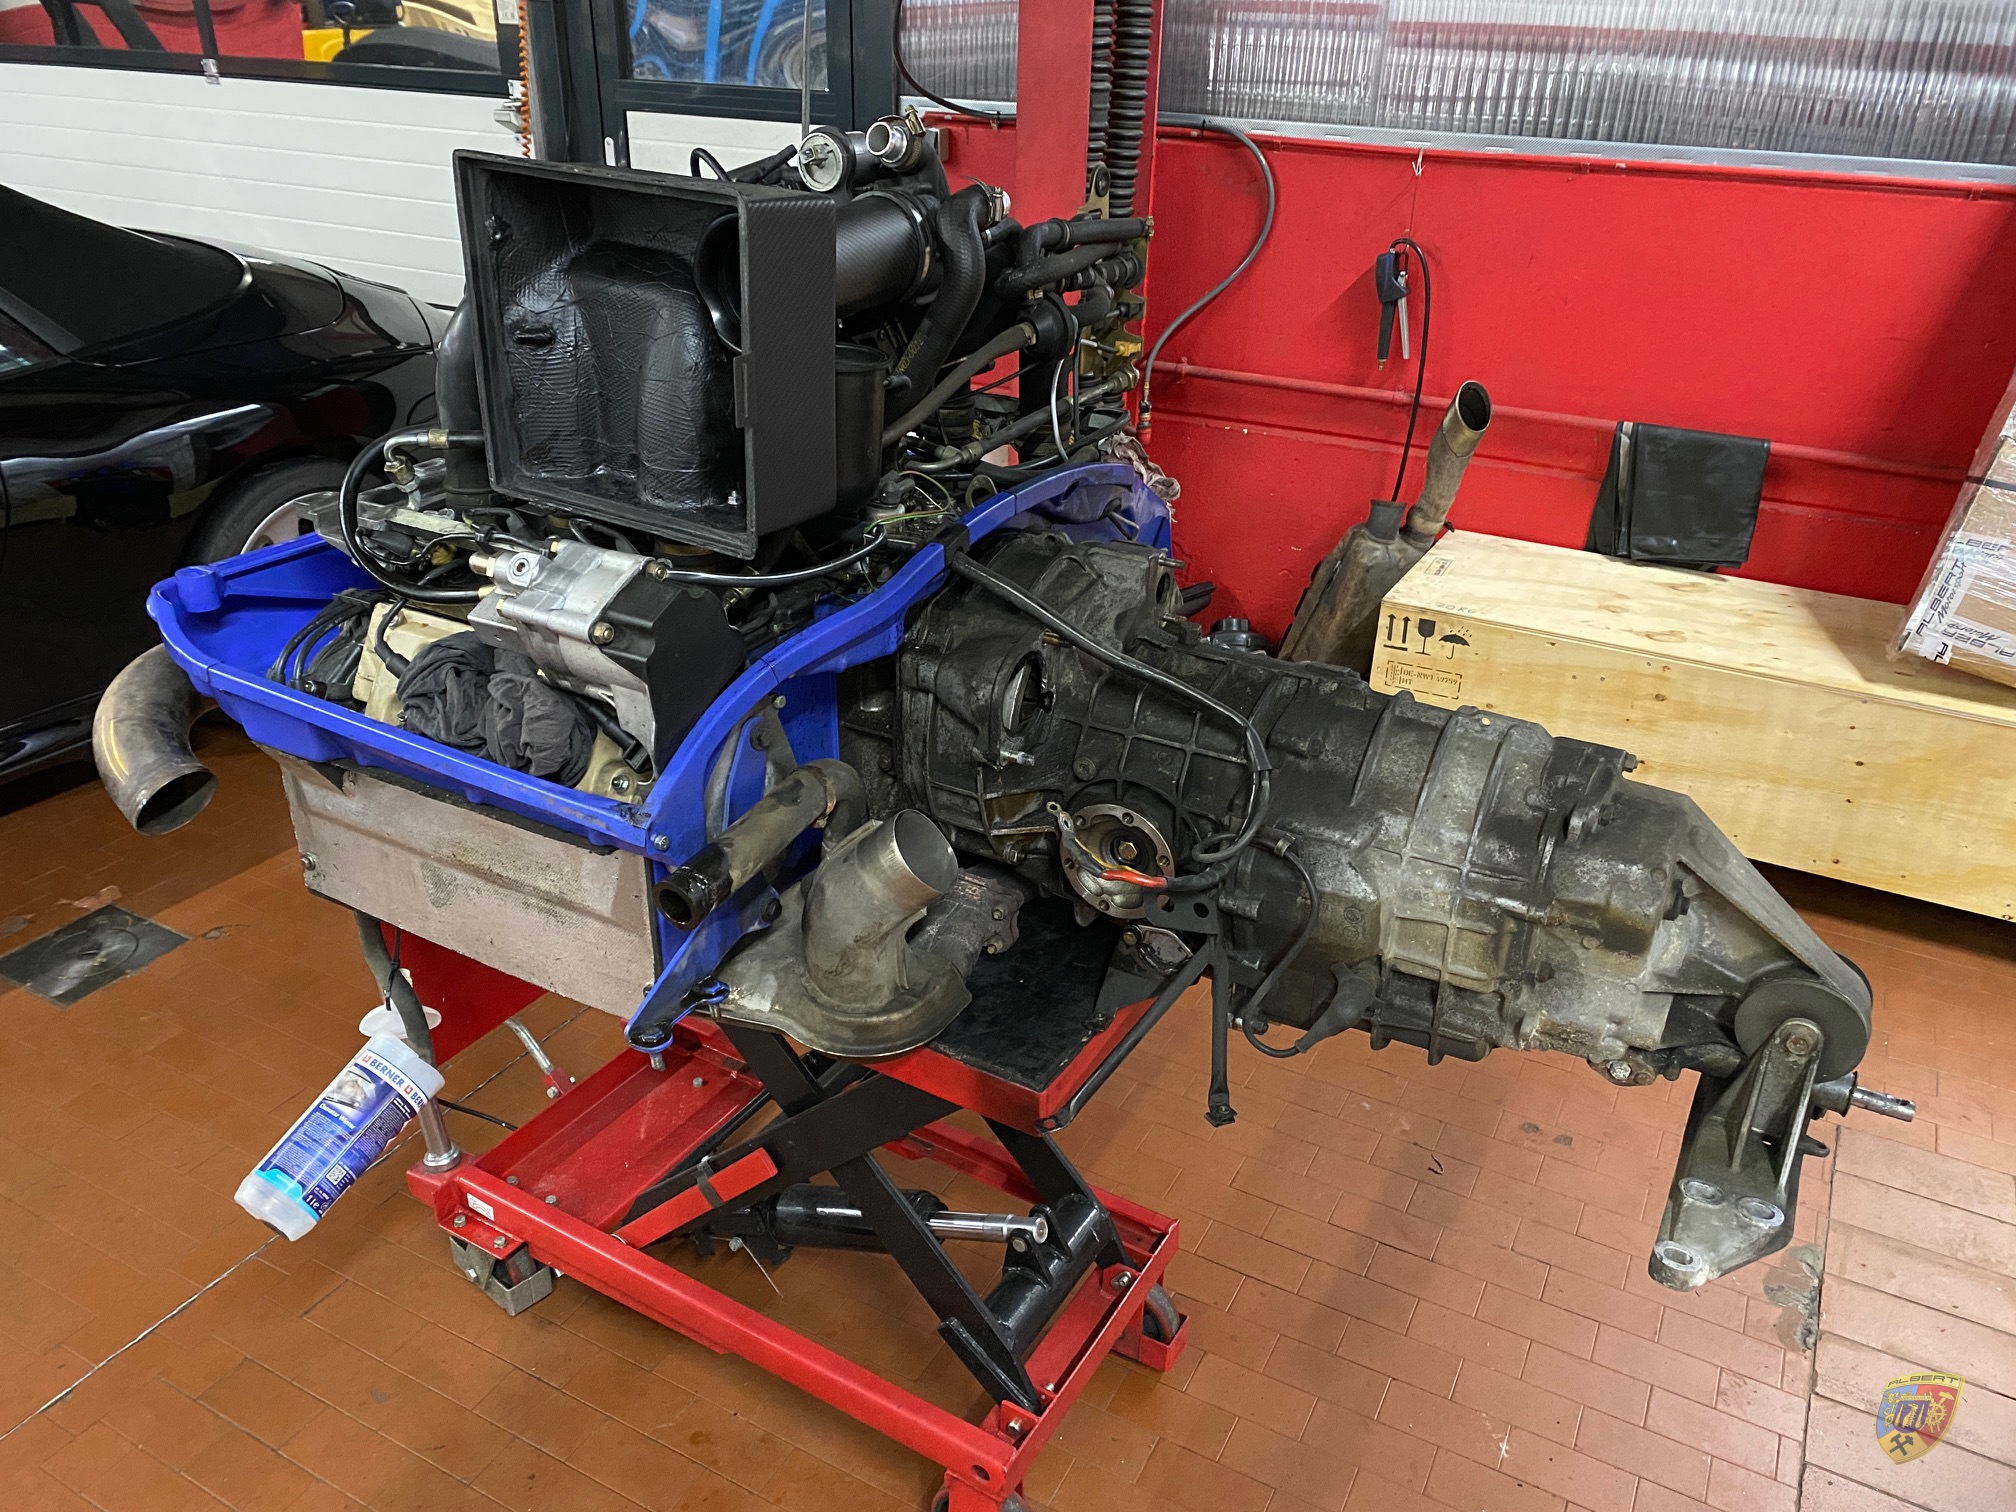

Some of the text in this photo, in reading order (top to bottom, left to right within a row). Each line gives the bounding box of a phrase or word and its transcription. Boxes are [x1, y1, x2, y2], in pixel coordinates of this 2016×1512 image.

[1916, 558, 1960, 636] ALBERT
[1937, 561, 1967, 623] Motorsport
[370, 1058, 405, 1087] BERNER
